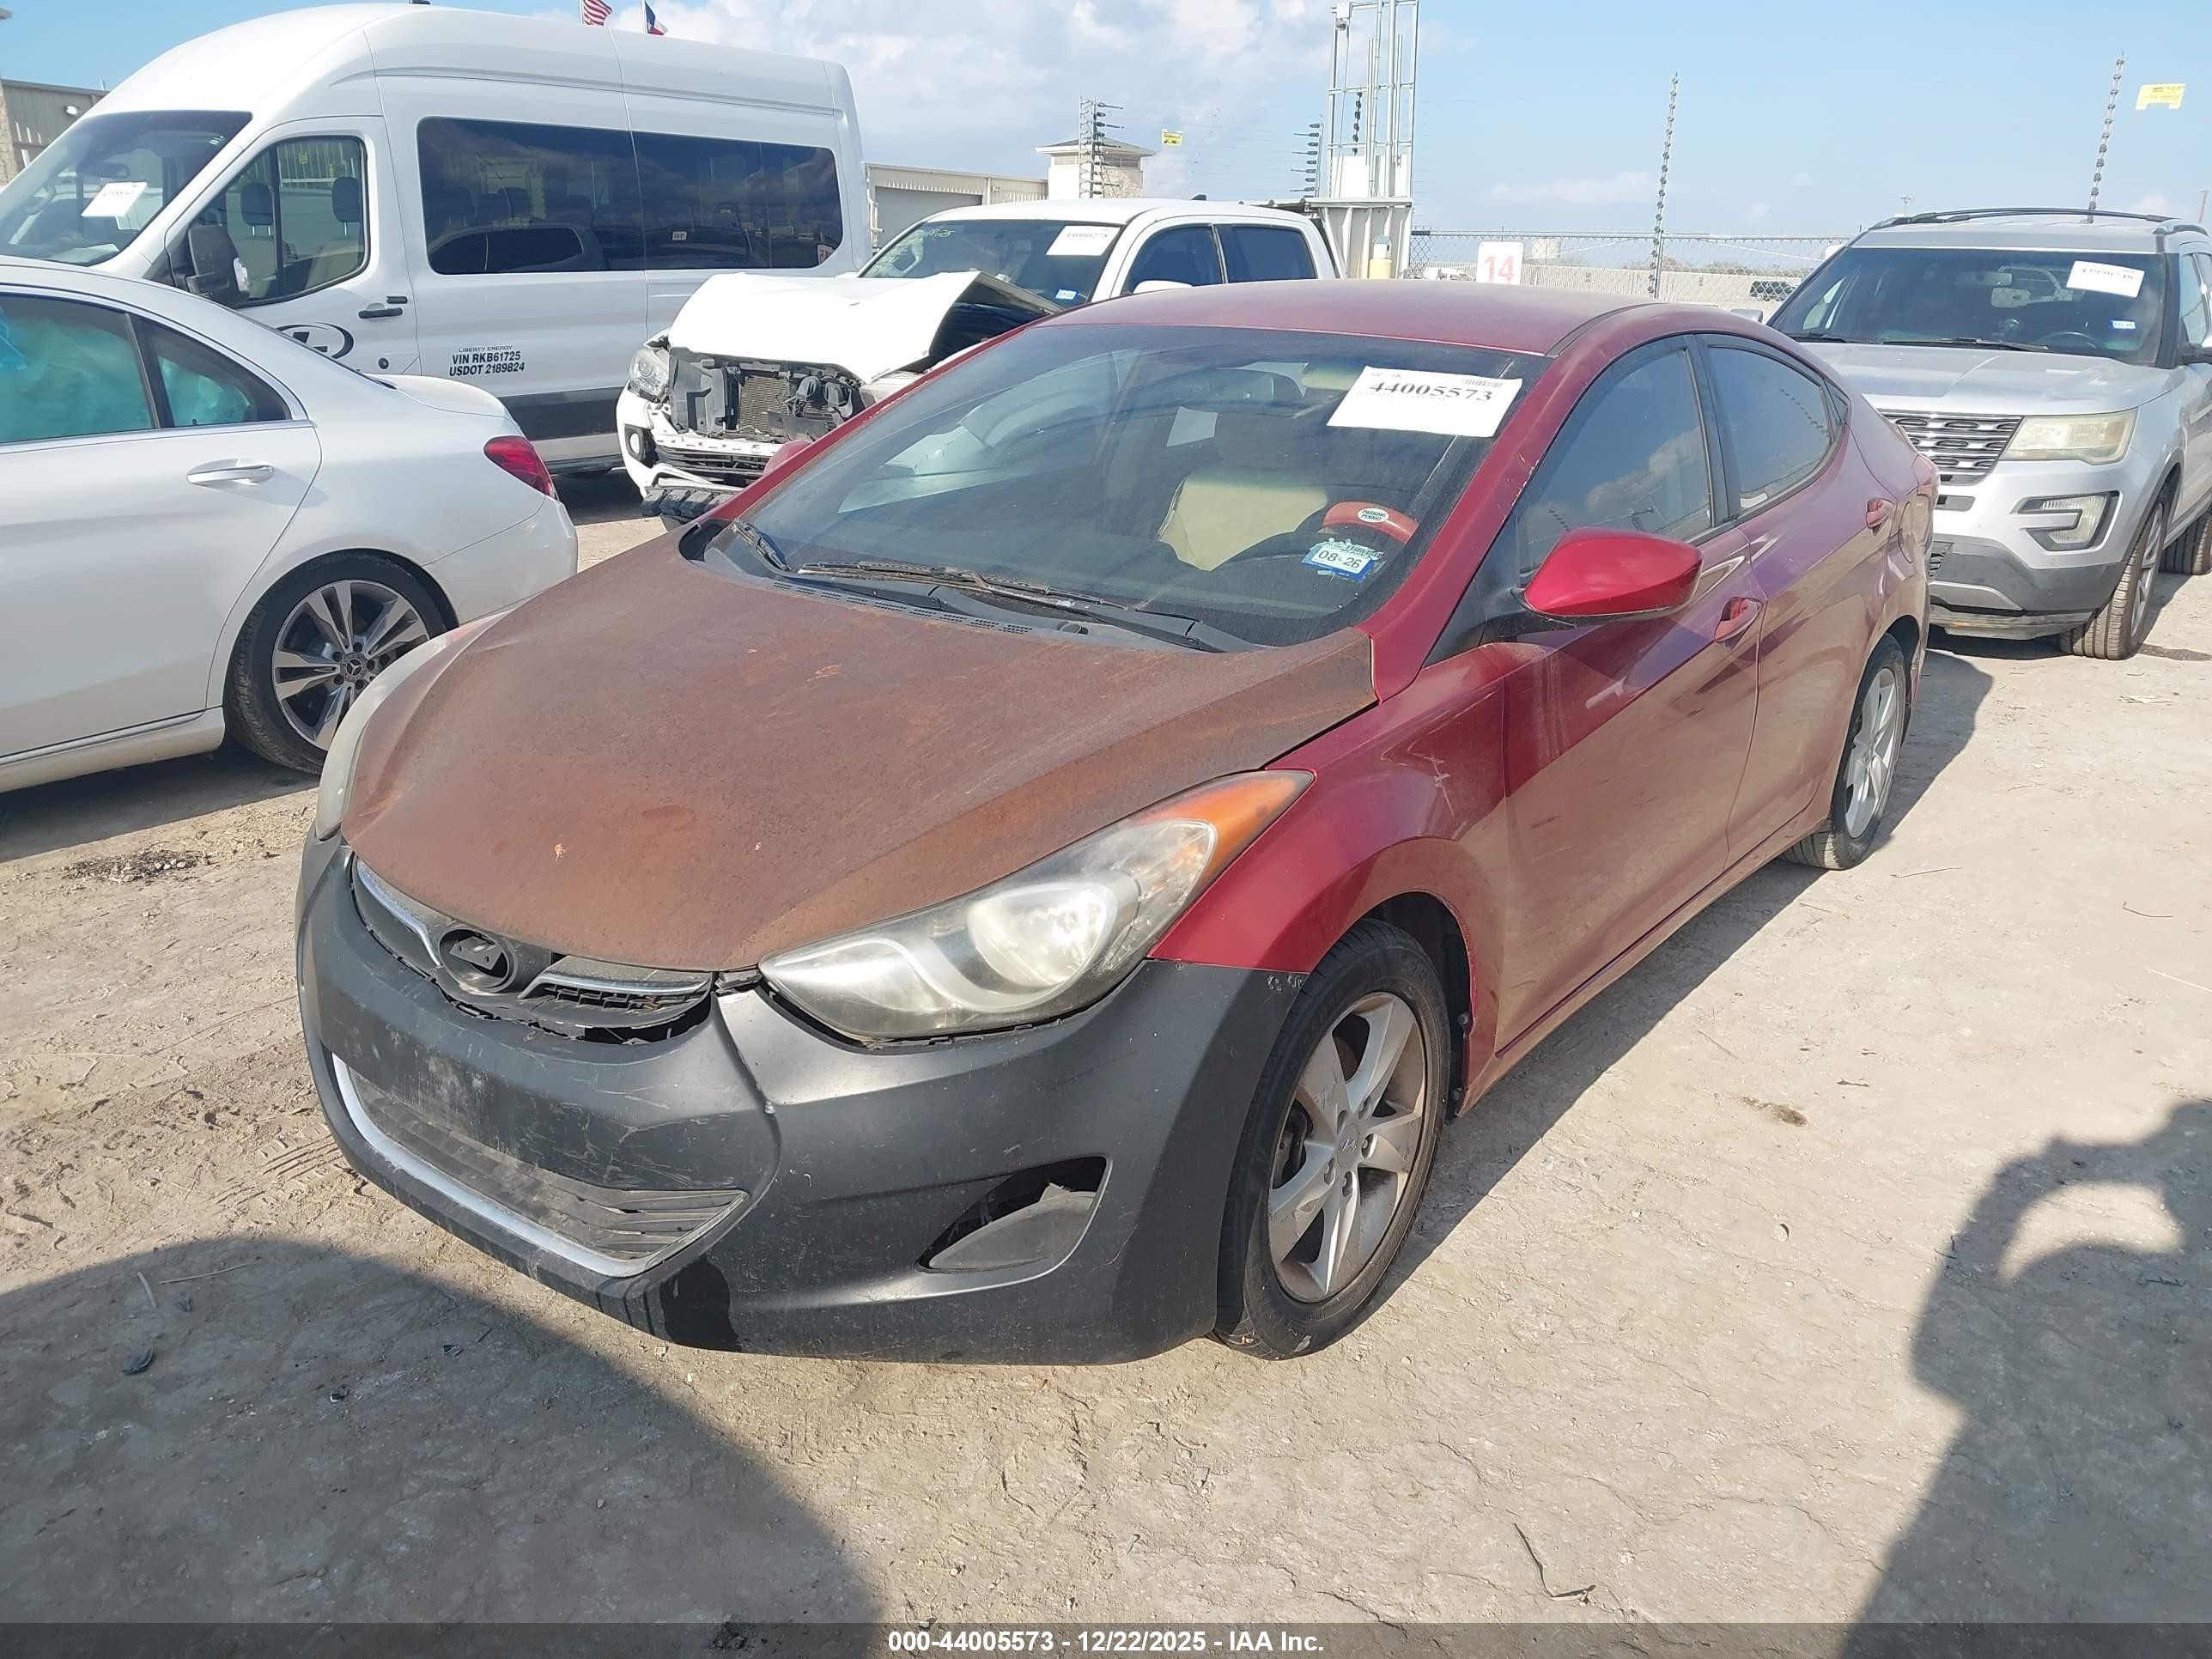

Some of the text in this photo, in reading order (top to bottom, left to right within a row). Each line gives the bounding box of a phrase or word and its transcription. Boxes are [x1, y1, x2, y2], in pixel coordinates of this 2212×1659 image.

[1484, 256, 1516, 283] 14
[452, 350, 521, 365] VIN RKB61725
[449, 362, 525, 377] USDOT 2189824
[1370, 381, 1493, 401] 44005573
